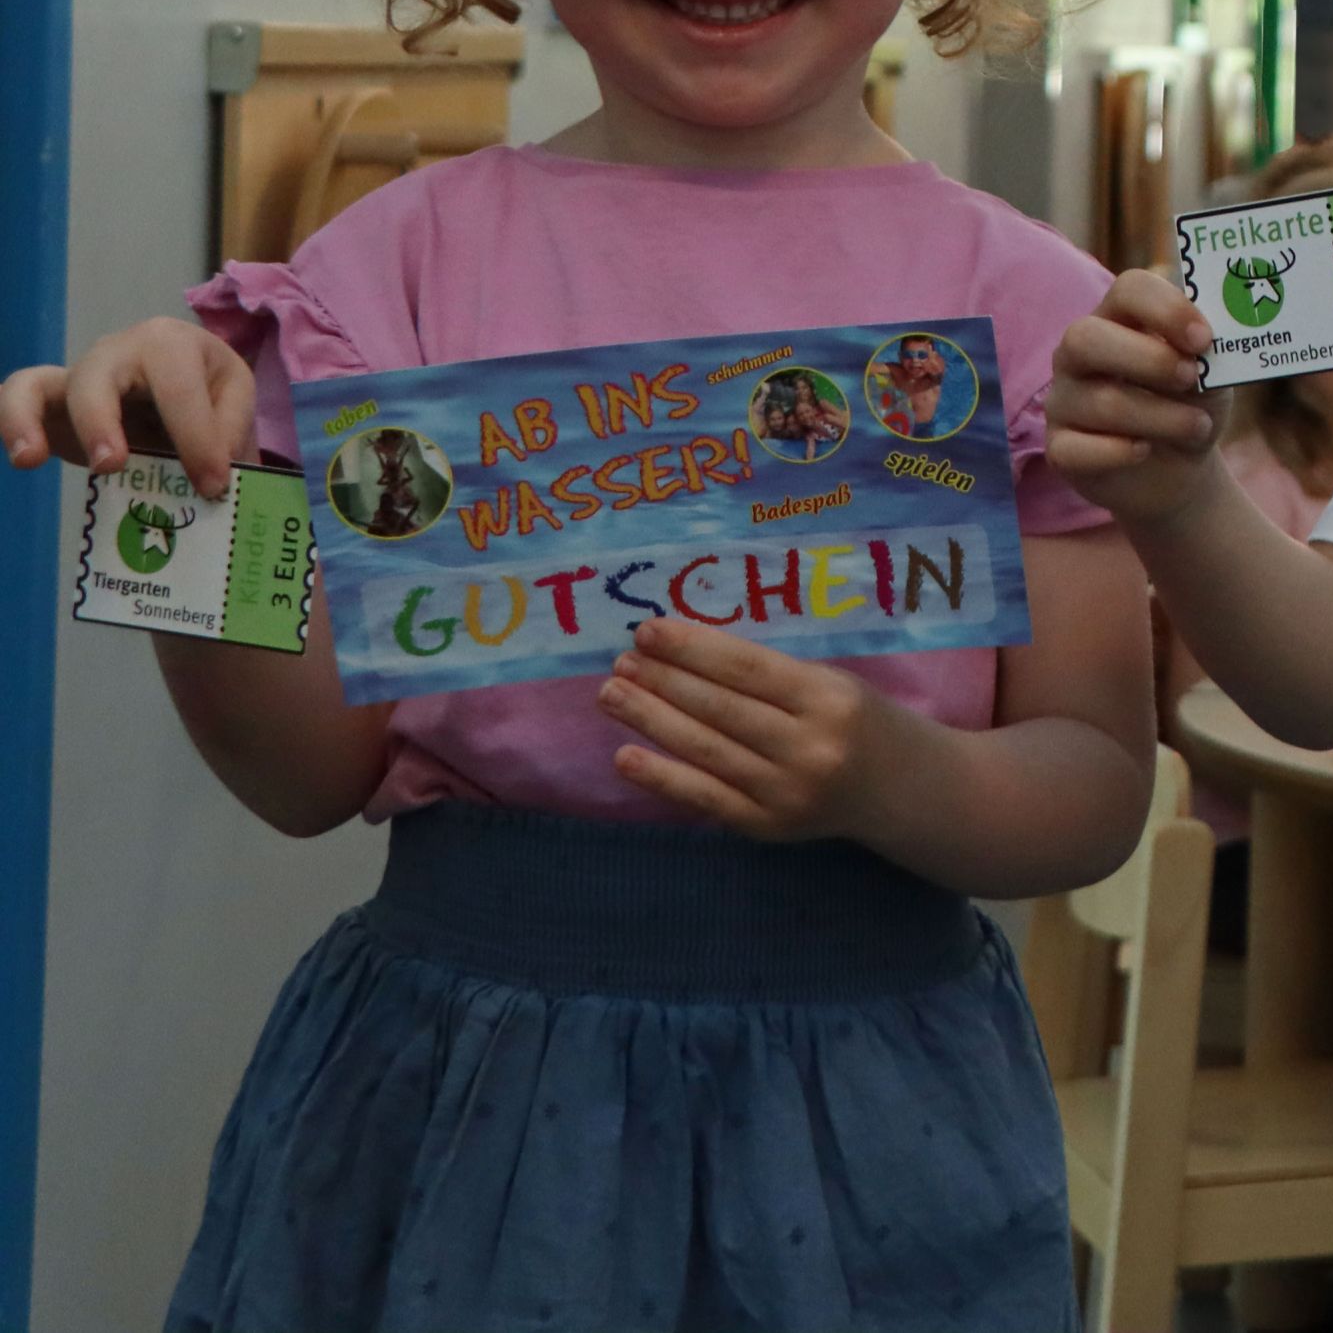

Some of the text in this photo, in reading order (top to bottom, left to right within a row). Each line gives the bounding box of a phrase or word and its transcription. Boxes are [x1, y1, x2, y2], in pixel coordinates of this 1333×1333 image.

[1194, 211, 1324, 255] Freikarte
[1212, 330, 1292, 354] Tiergarten
[707, 344, 794, 385] schwimmen
[323, 399, 379, 437] toben
[480, 363, 700, 467] AB INS
[100, 463, 229, 502] reika
[457, 428, 752, 551] WASSER!
[885, 451, 976, 494] spielen
[751, 483, 851, 524] Badespaß
[240, 512, 267, 604] Kinder
[271, 516, 301, 610] 3 Euro
[94, 572, 171, 598] Tiergarten
[393, 536, 964, 656] GUTSCHEIN
[133, 600, 215, 629] Sonneberg
